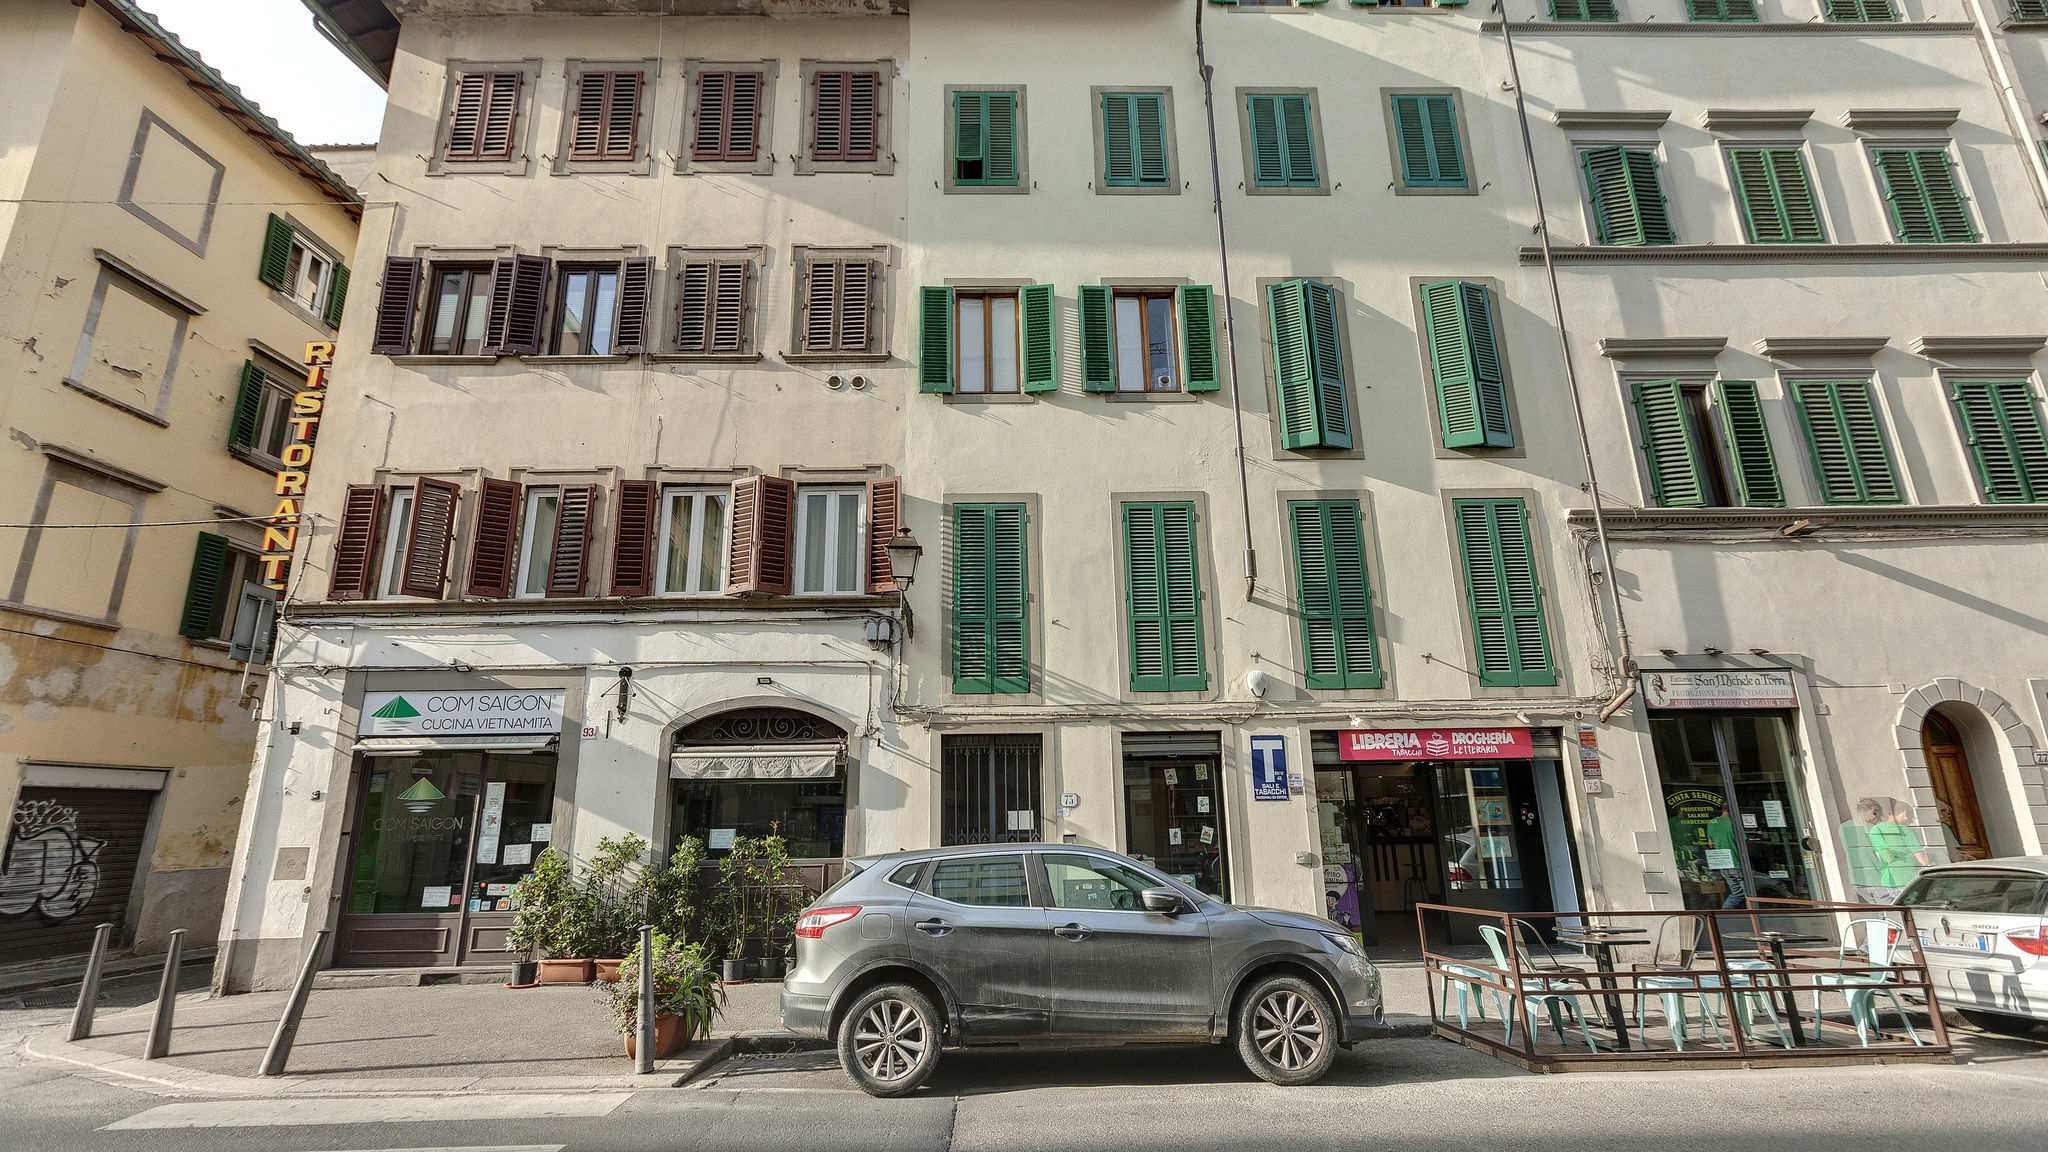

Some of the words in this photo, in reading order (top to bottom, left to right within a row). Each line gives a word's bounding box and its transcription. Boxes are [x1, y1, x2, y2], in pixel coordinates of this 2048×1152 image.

[259, 341, 336, 600] RISTORANT
[1693, 673, 1714, 689] San
[1714, 673, 1753, 688] Michele
[1754, 677, 1761, 686] a
[1760, 673, 1787, 686] Torri
[427, 696, 475, 713] COM
[478, 694, 552, 712] SAIGON
[422, 718, 474, 730] CUCINA
[477, 717, 553, 729] VIETNAMITA
[582, 727, 595, 737] 93
[1351, 732, 1422, 750] LIBRERIA
[1391, 749, 1423, 757] TABACCHI
[1453, 745, 1499, 755] LETTERARIA
[1252, 740, 1283, 782] T
[1667, 792, 1690, 806] CINTA
[1691, 791, 1723, 805] SENESE
[410, 816, 464, 831] SAIGON
